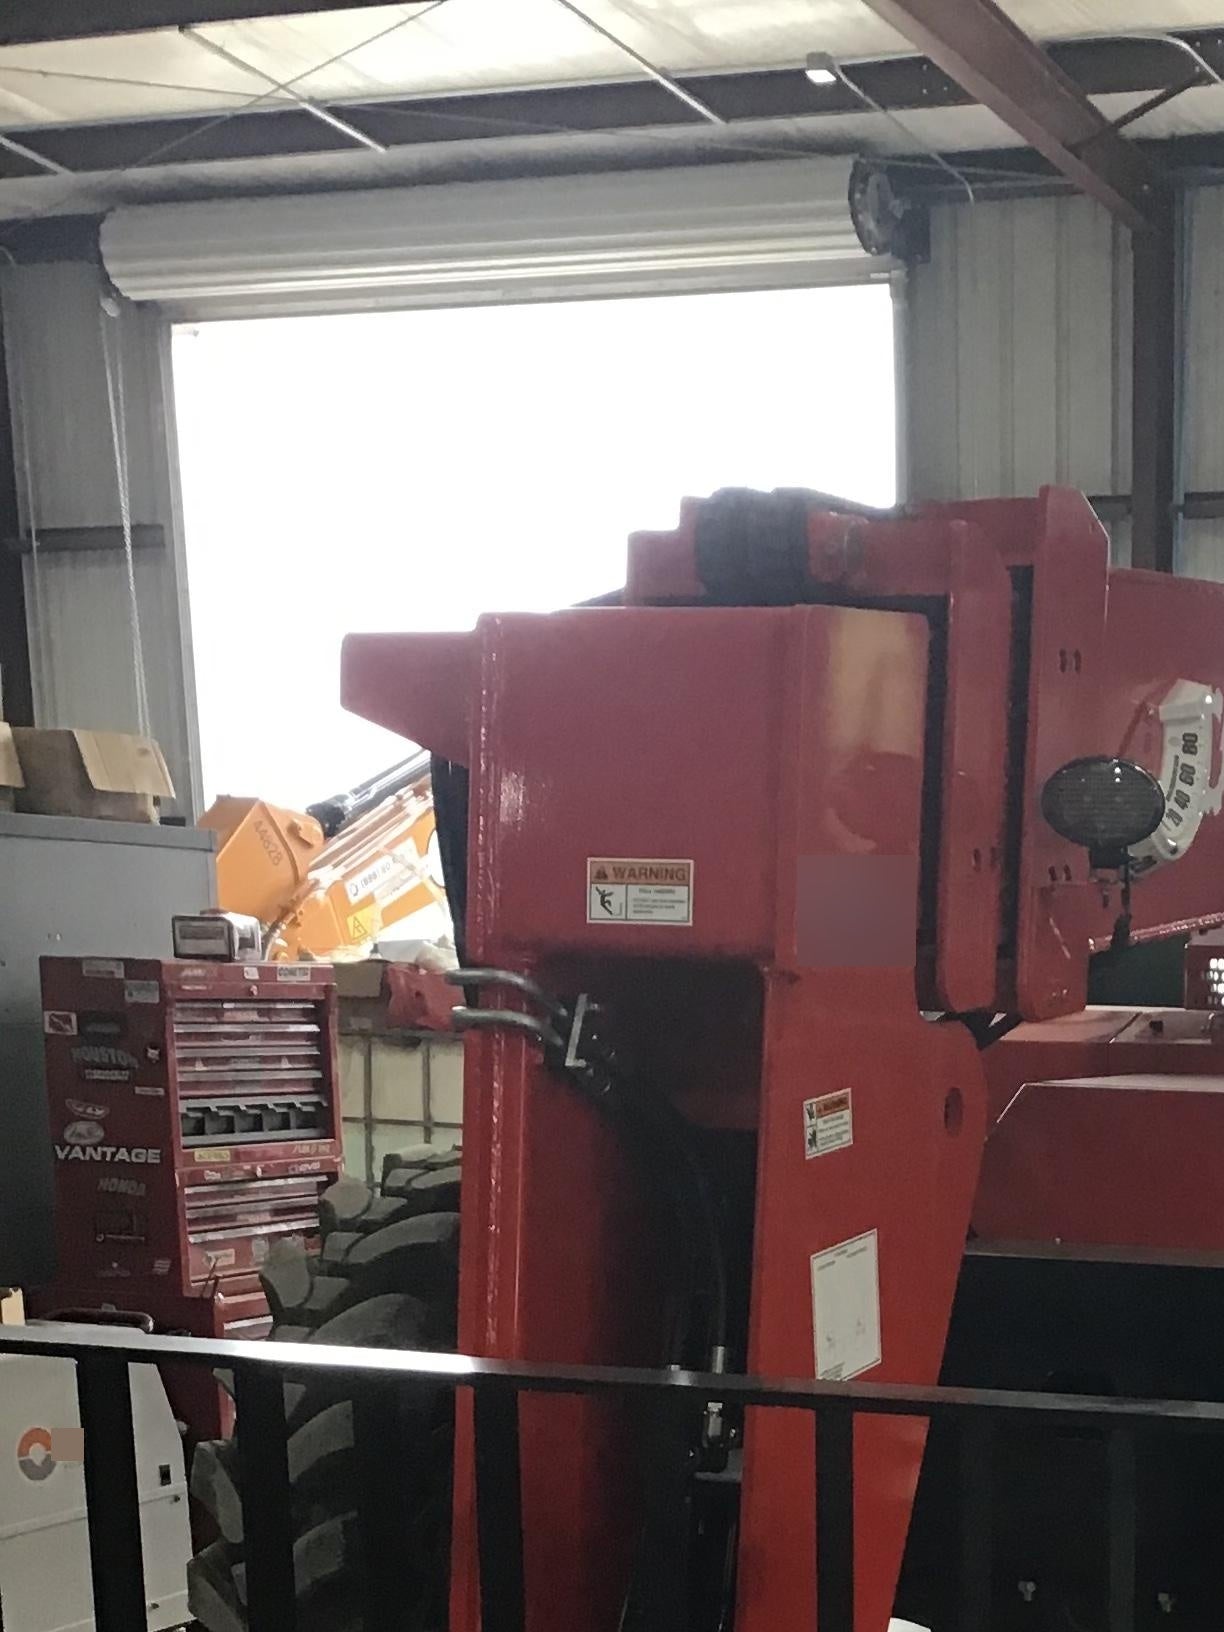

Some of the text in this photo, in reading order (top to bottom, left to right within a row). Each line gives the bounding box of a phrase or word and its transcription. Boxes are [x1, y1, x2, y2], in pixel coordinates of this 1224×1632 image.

[1182, 732, 1198, 756] 80
[1179, 763, 1196, 787] 60
[1174, 789, 1191, 810] 40
[612, 866, 686, 880] WARNING
[54, 1144, 161, 1164] VANTAGE
